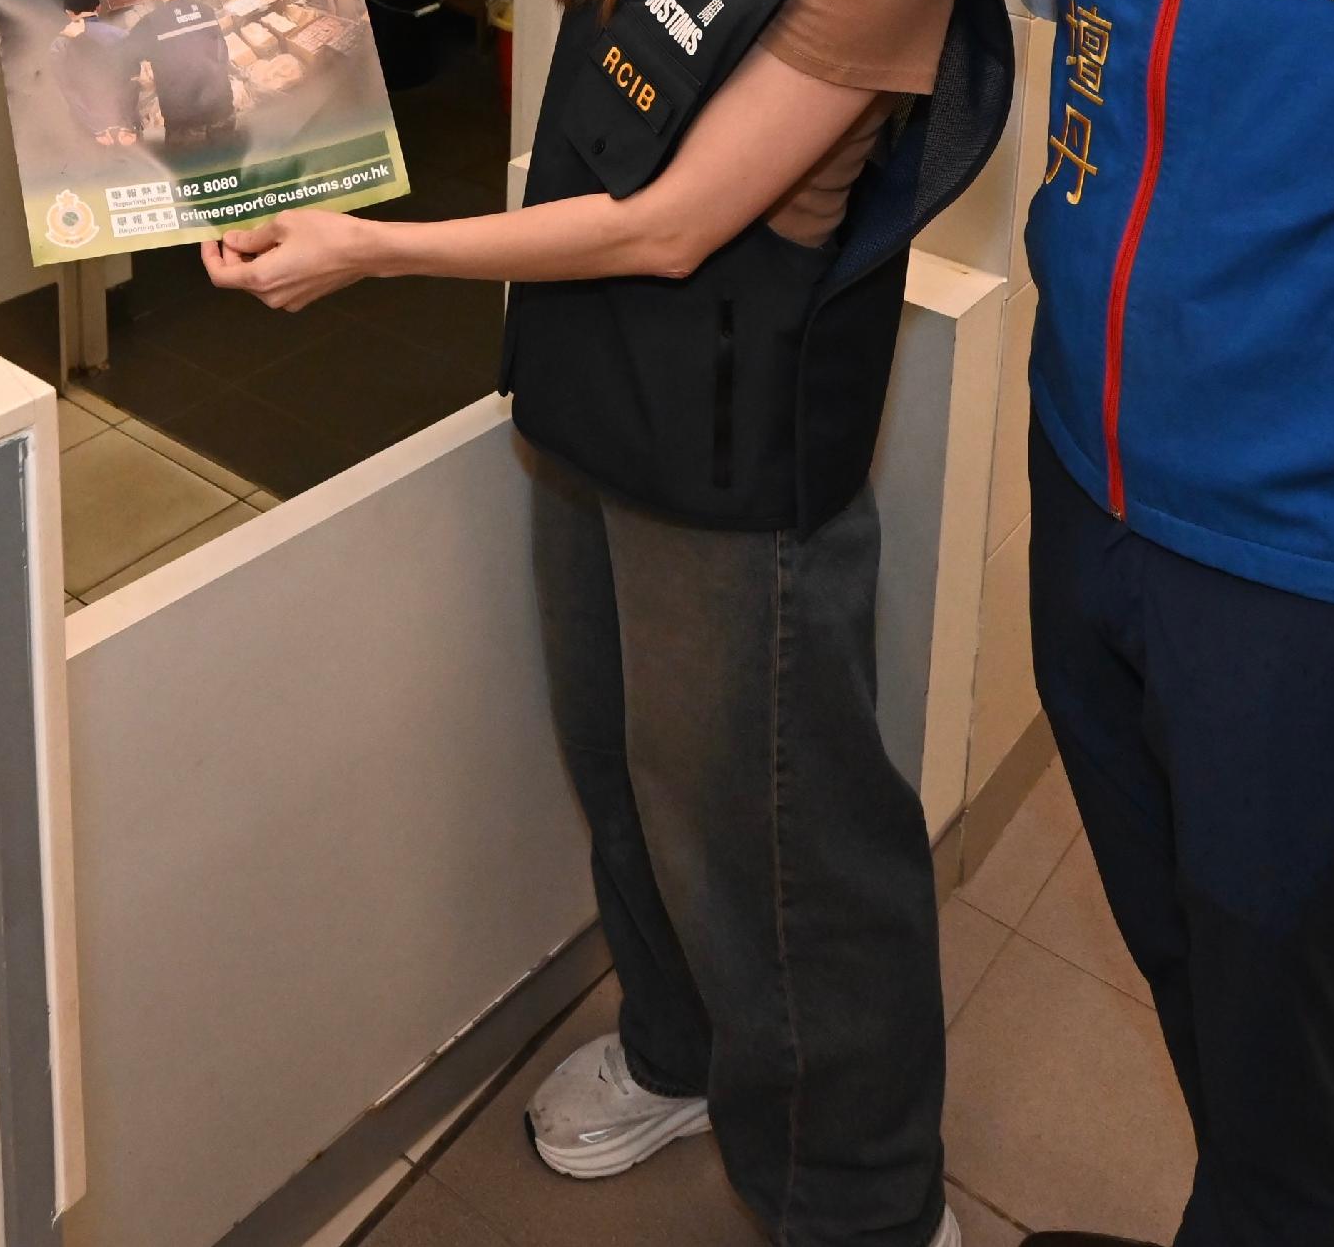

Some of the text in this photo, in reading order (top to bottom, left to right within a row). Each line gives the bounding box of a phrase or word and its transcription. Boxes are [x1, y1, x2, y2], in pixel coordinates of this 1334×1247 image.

[602, 46, 656, 112] RCIB
[175, 176, 238, 198] 182 8080
[180, 164, 390, 222] crimereport@customs.gov.hk
